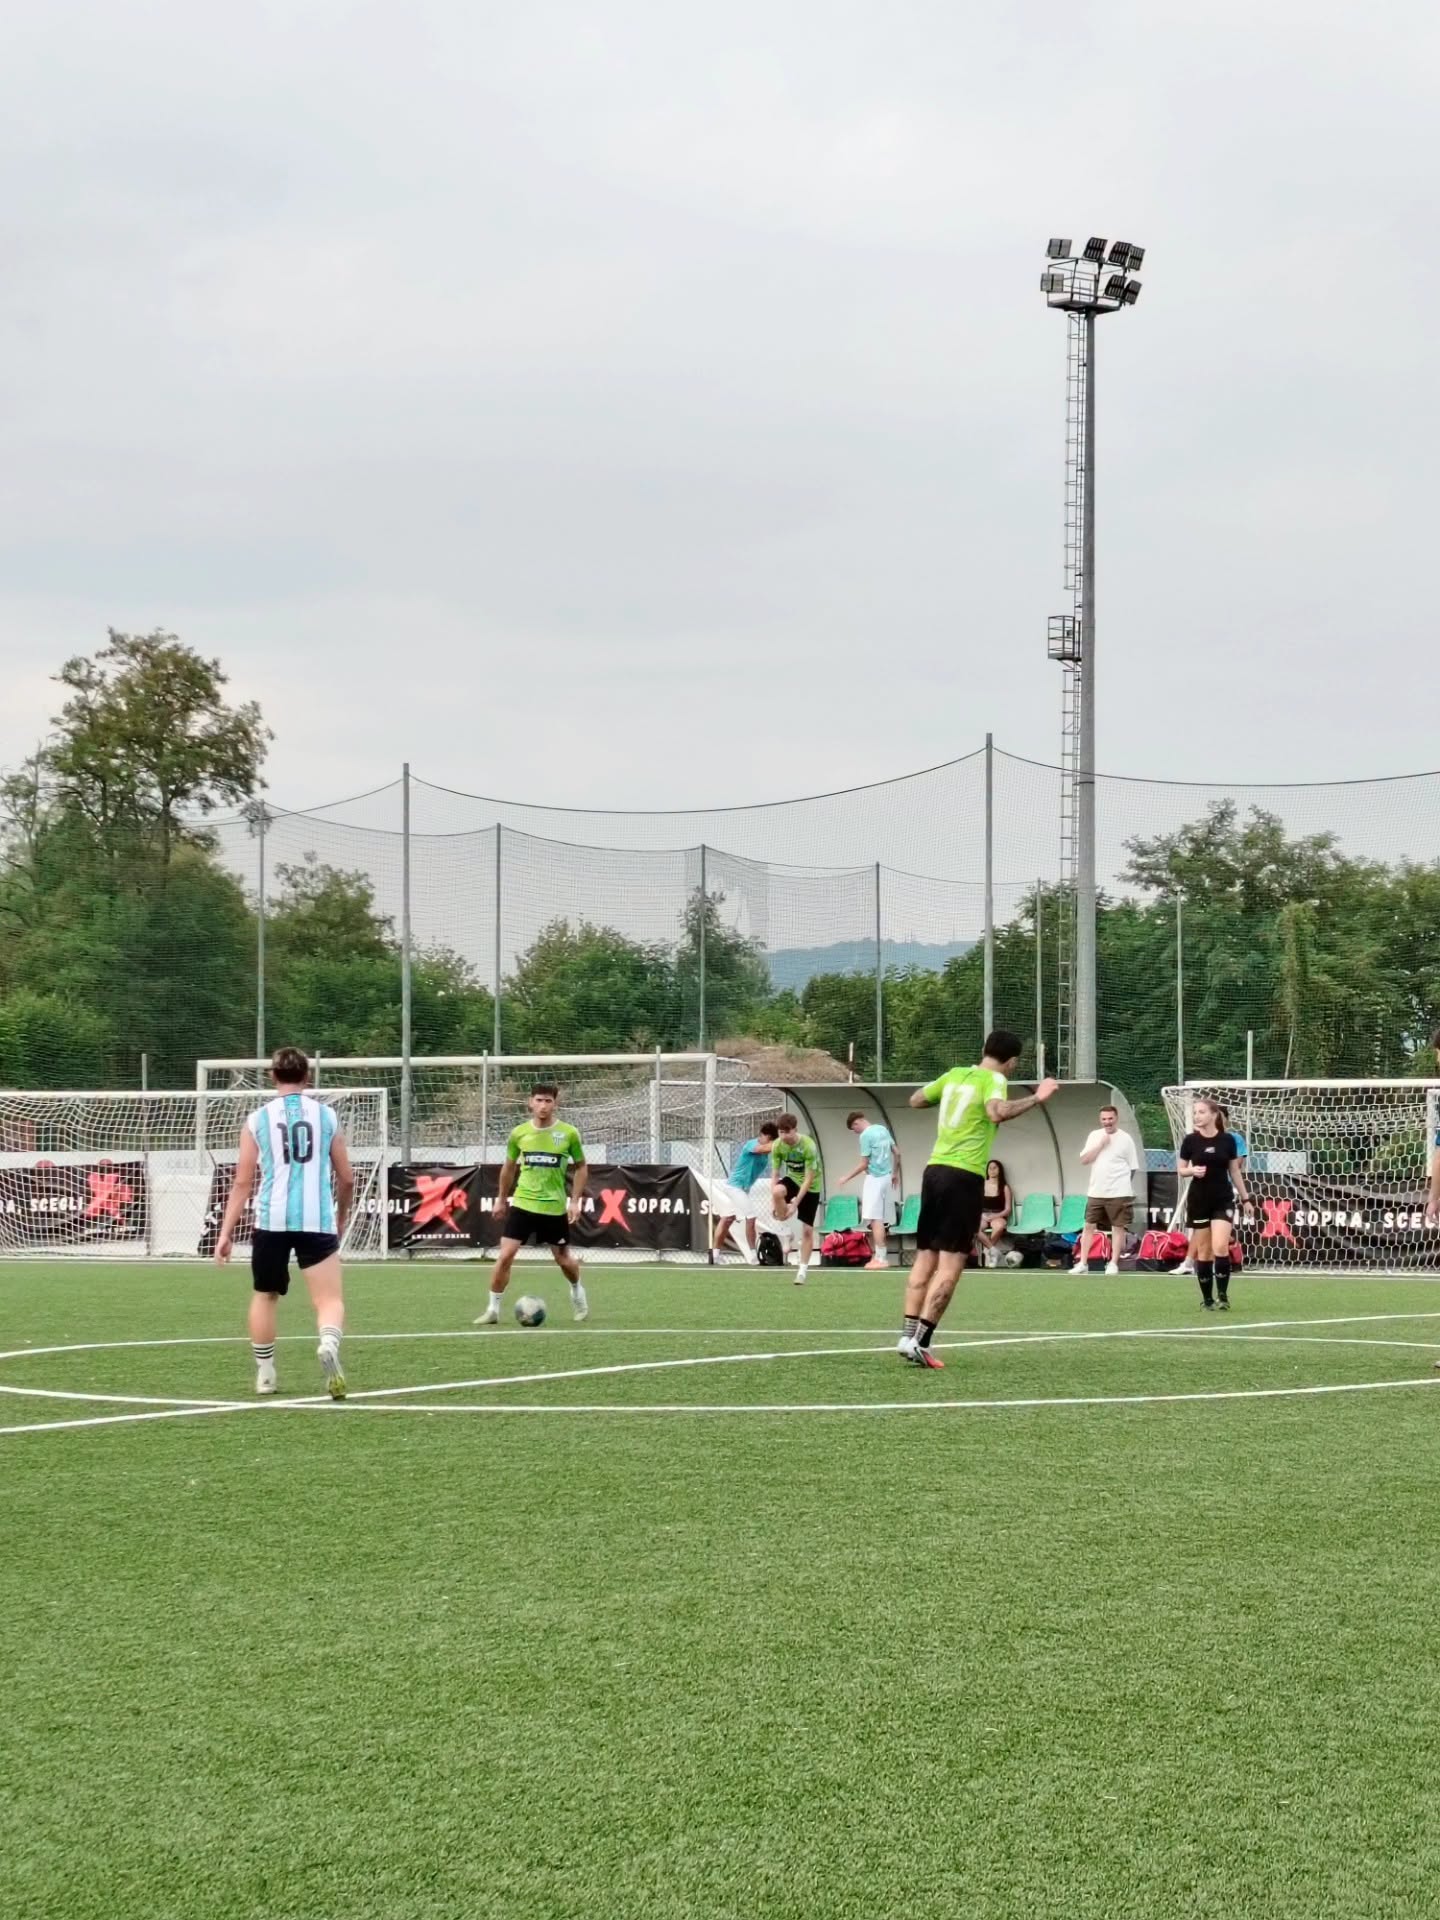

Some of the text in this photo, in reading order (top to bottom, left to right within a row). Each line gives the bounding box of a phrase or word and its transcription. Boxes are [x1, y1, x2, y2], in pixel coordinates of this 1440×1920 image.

[277, 1121, 313, 1164] 10
[627, 1197, 690, 1216] SOPRA,
[1294, 1210, 1371, 1230] SOPRA,
